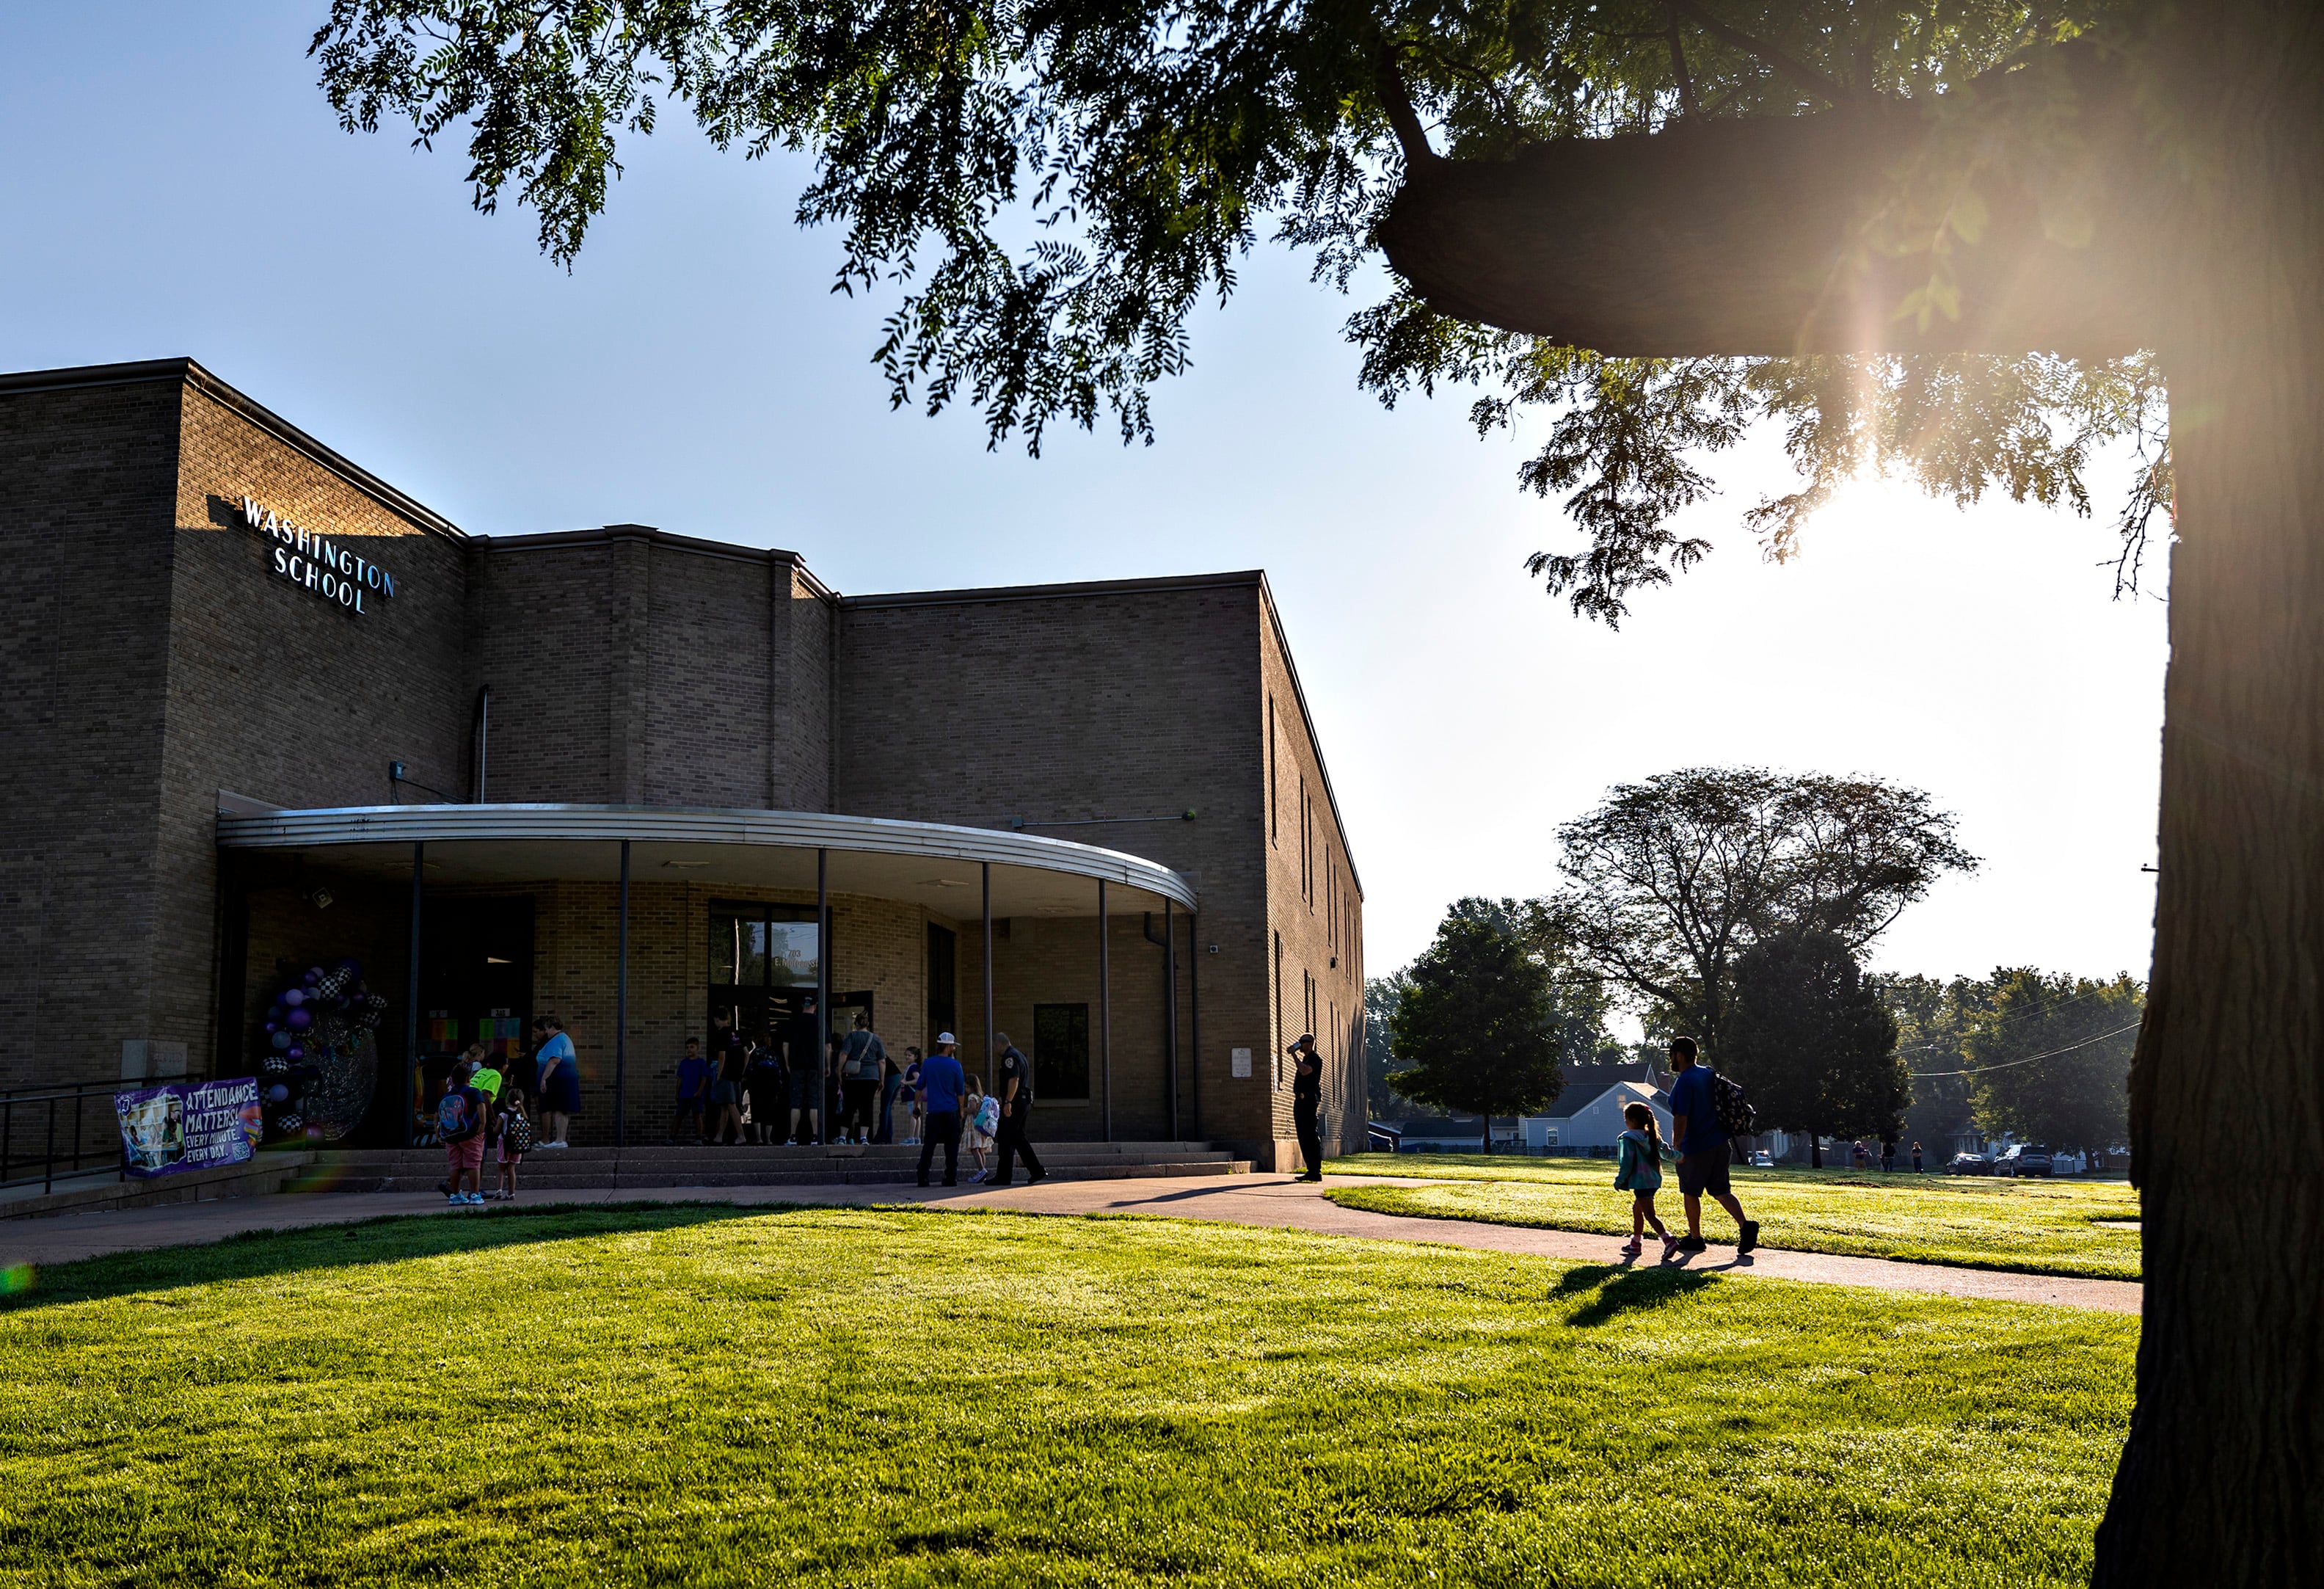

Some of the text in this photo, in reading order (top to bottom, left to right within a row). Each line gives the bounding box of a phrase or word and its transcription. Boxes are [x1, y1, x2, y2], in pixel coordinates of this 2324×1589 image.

[244, 495, 394, 598] WASHINGTON
[274, 547, 365, 615] SCHOOL
[788, 950, 801, 958] 703
[186, 1082, 258, 1110] ATTENDANCE
[185, 1108, 239, 1133] MATTERS!
[186, 1129, 241, 1149] EVERY MINUTE.
[187, 1144, 229, 1163] EVERY DAY.
